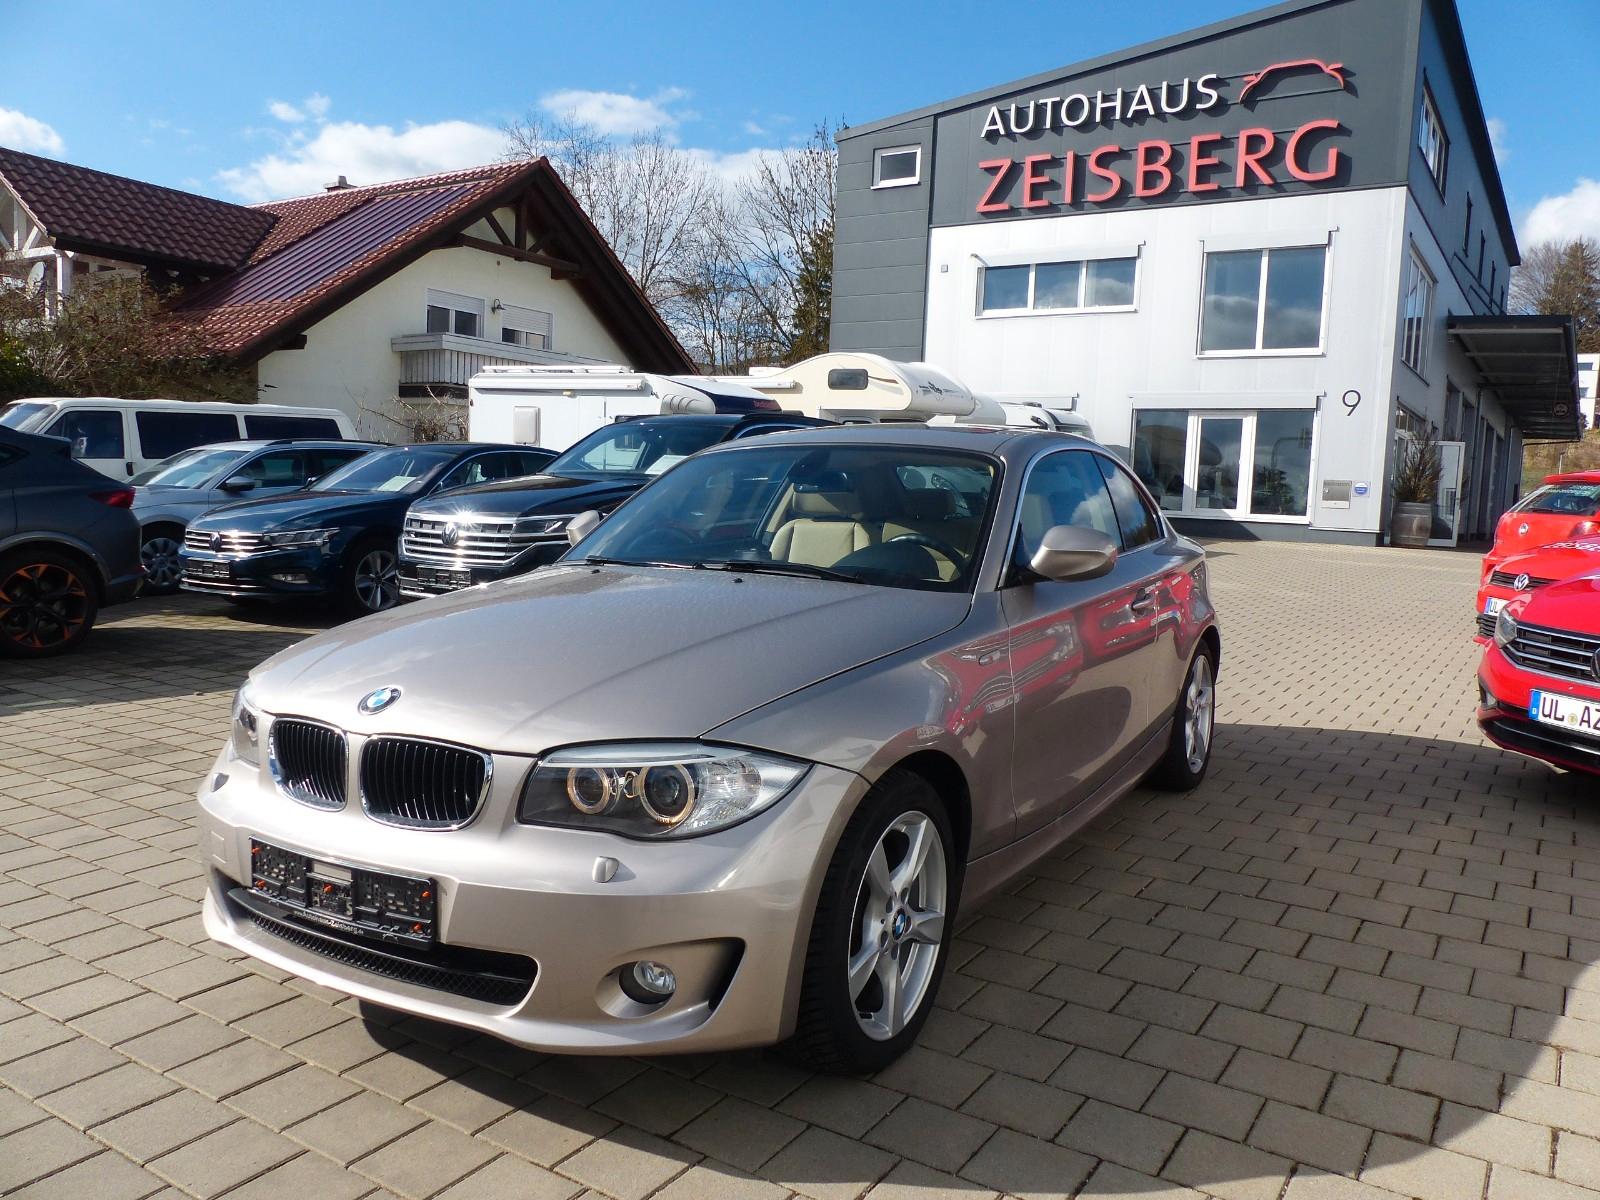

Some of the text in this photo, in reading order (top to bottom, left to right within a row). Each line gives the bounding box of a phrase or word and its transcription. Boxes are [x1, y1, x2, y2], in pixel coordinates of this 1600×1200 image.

[980, 73, 1218, 138] AUTOHAUS
[975, 119, 1340, 213] ZEISBERG
[1342, 389, 1361, 417] 9
[1541, 696, 1565, 722] UL
